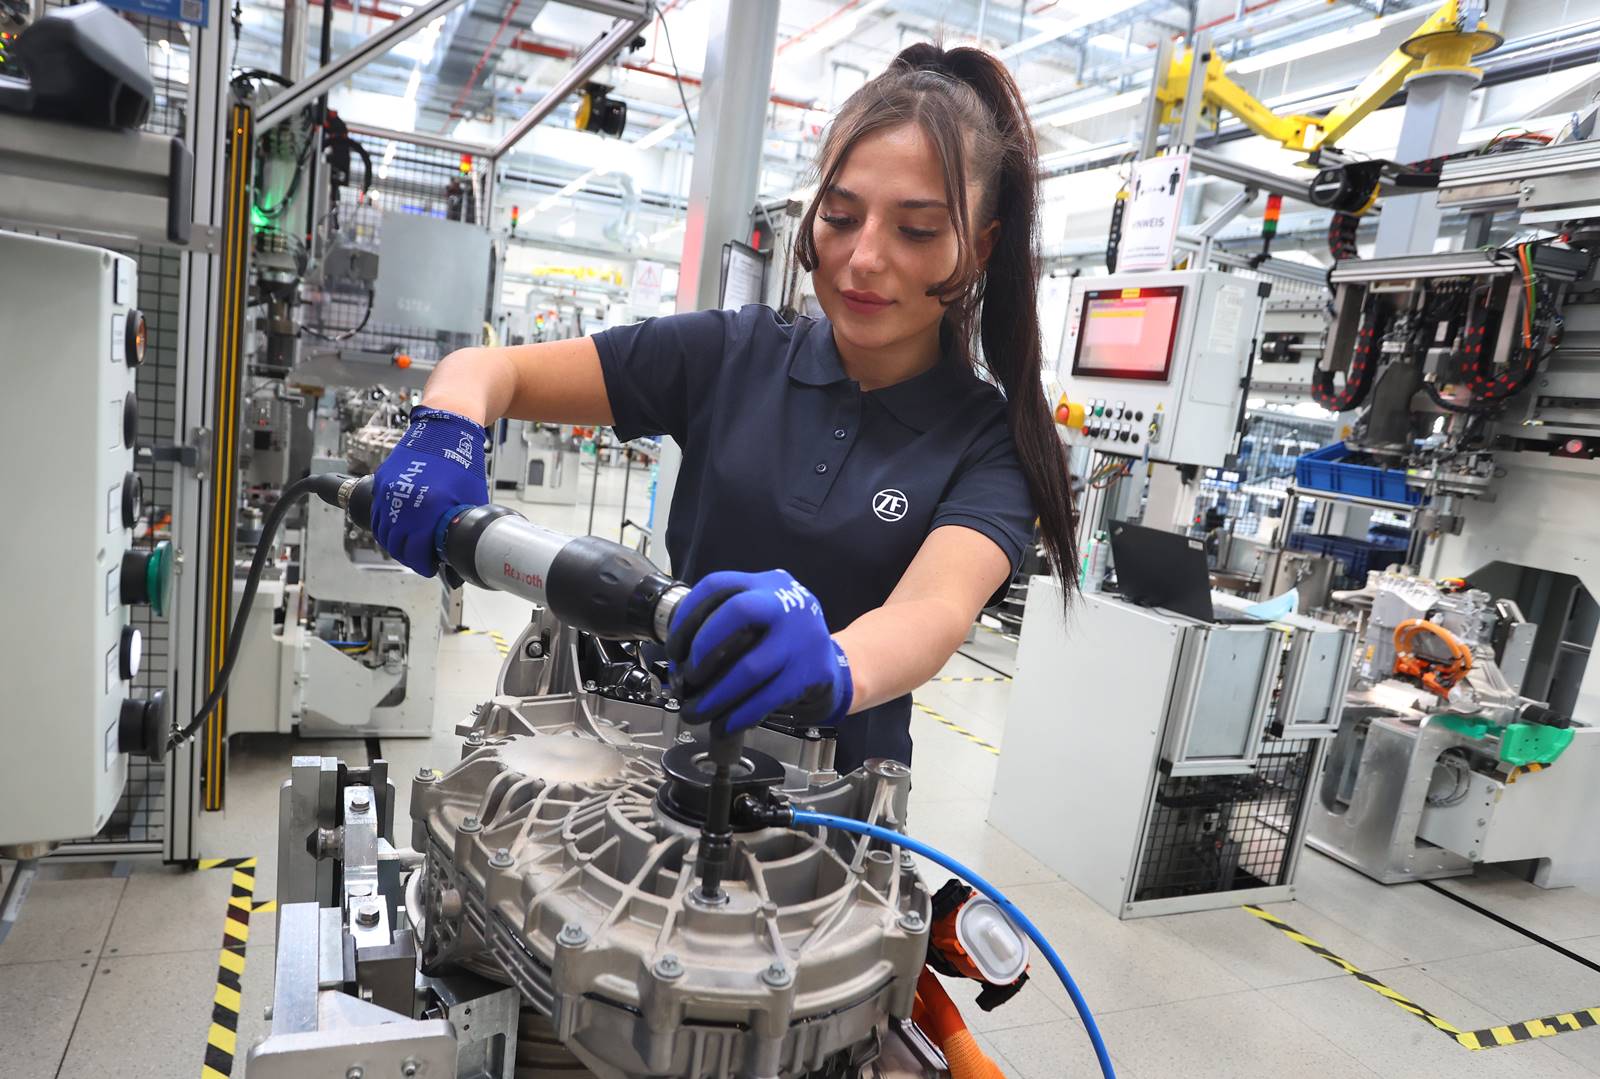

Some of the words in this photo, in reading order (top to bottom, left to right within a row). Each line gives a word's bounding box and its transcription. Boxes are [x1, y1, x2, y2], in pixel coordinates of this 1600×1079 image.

[443, 449, 472, 469] Ansell
[388, 461, 427, 522] HyFlex
[874, 491, 908, 519] ZF
[503, 562, 544, 589] Rexroth
